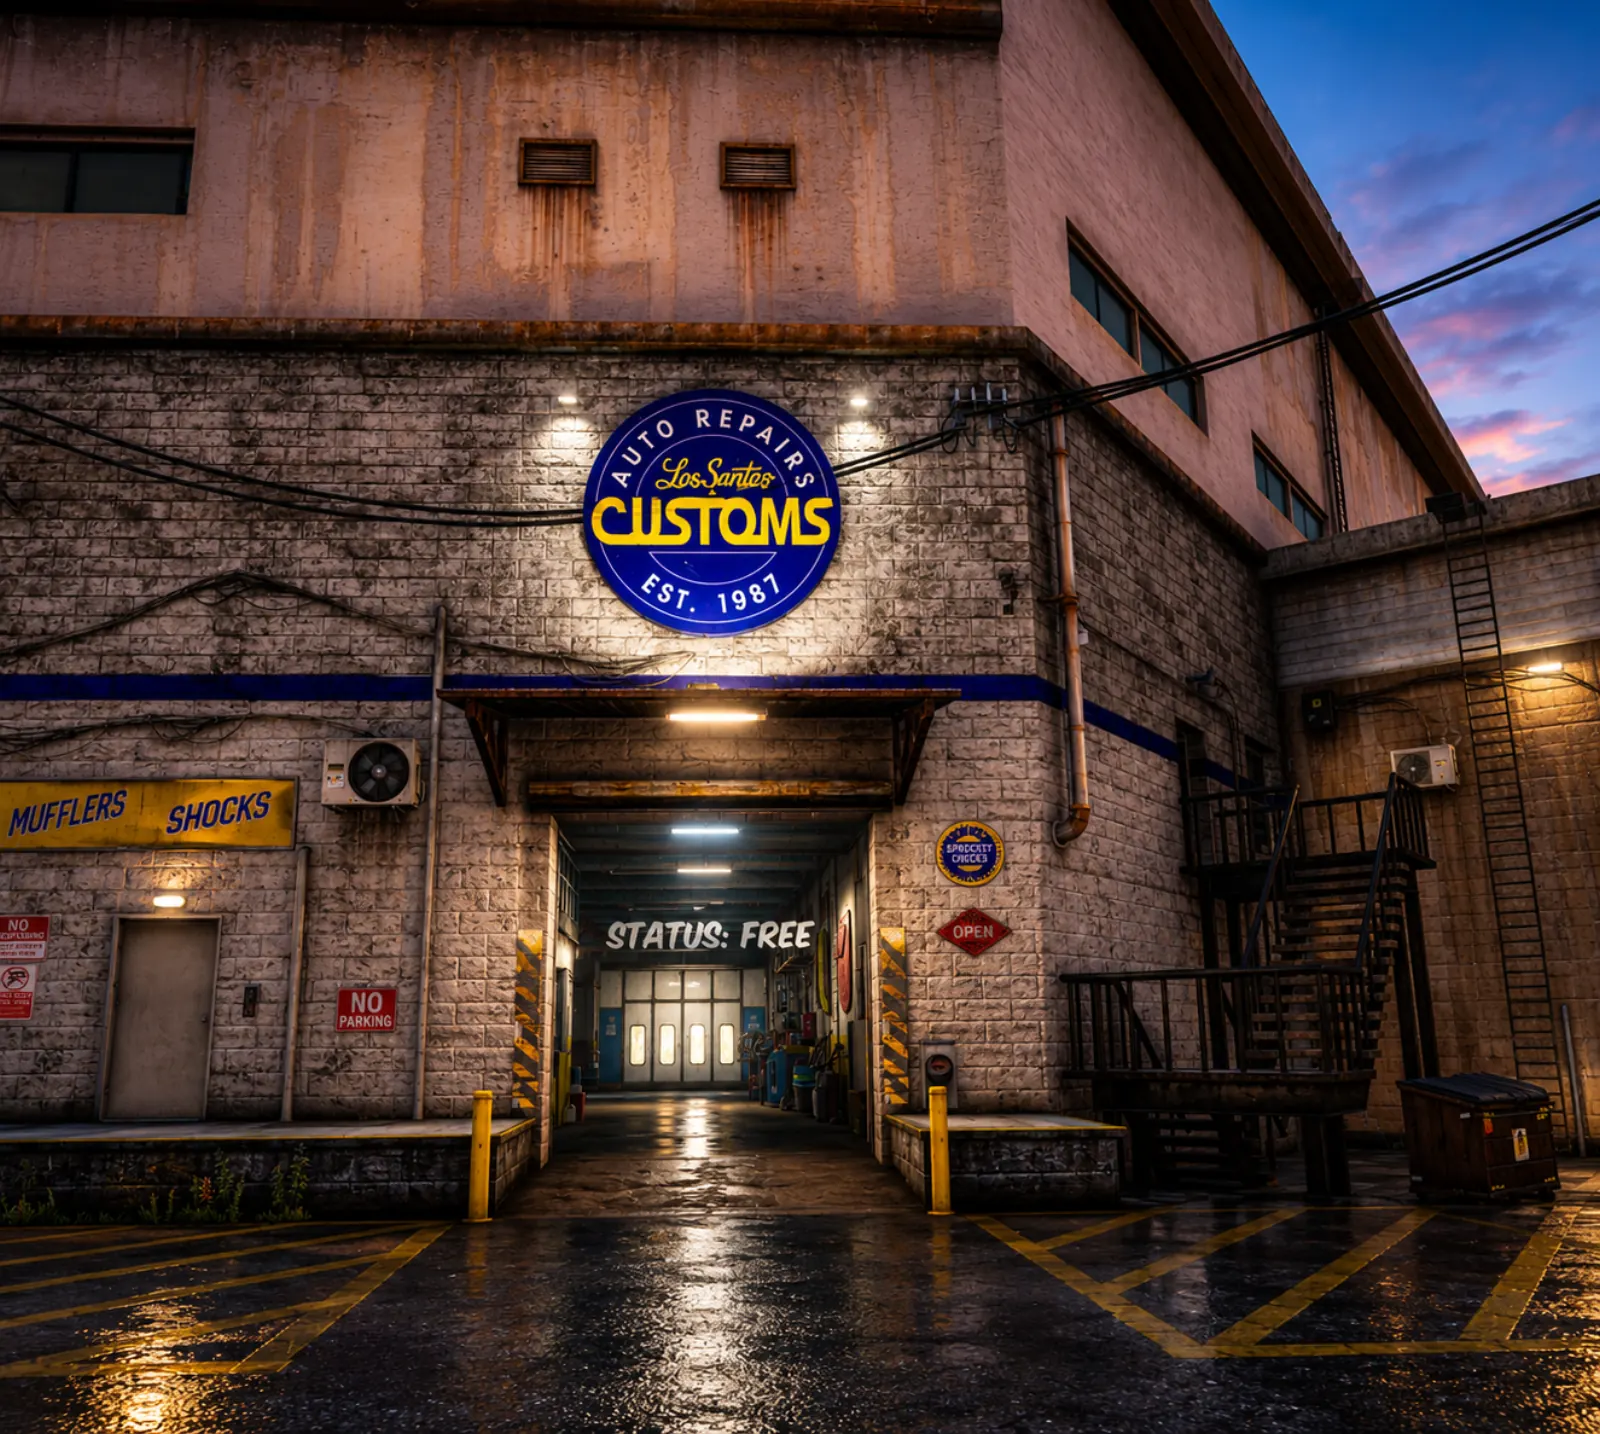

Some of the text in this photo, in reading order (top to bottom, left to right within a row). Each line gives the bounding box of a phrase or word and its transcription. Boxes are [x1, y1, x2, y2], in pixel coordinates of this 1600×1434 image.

[611, 408, 815, 489] AUTO REPAIRS
[655, 457, 701, 490] Los
[591, 496, 834, 546] CUSTOMS
[640, 573, 780, 613] EST. 1987
[8, 789, 128, 837] MUFFLERS
[166, 790, 272, 834] SHOCKS
[8, 919, 29, 932] NO
[953, 925, 994, 939] OPEN
[351, 991, 383, 1013] NO
[339, 1014, 392, 1028] PARKING
